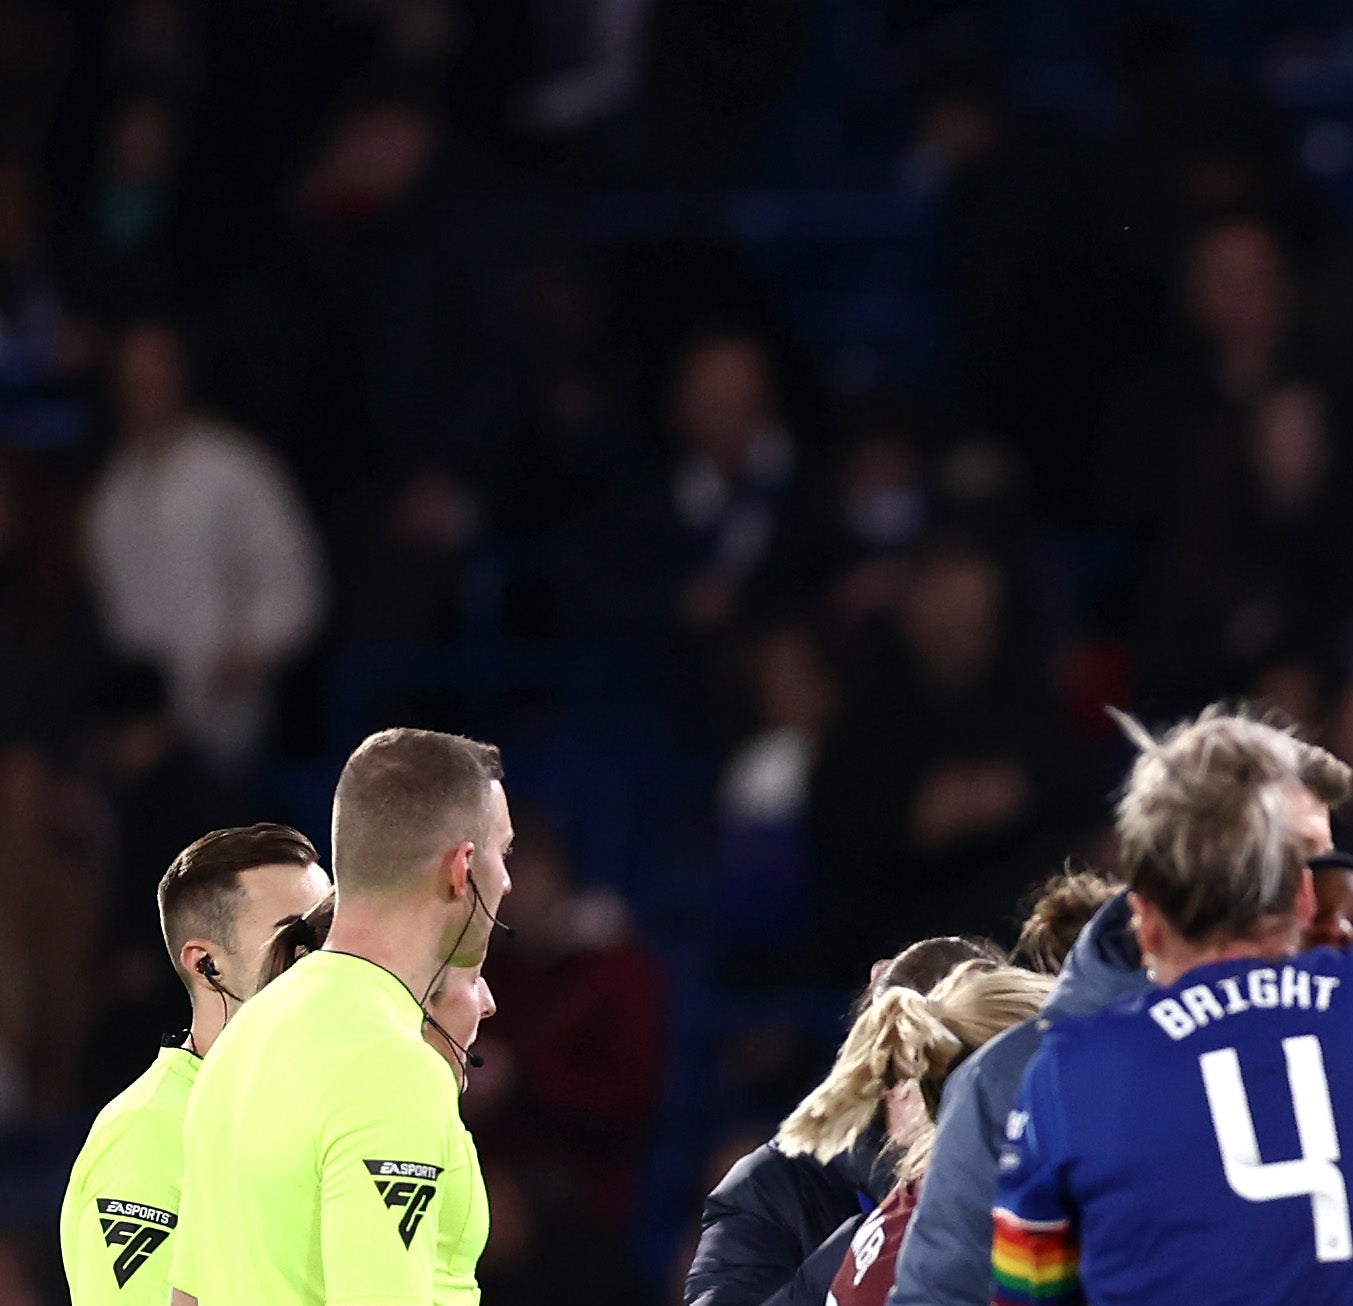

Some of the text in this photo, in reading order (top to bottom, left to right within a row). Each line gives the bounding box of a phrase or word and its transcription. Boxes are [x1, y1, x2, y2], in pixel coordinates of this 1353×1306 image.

[1149, 965, 1341, 1042] BRIGHT
[124, 1203, 172, 1225] SPORTS
[98, 1217, 171, 1290] FC
